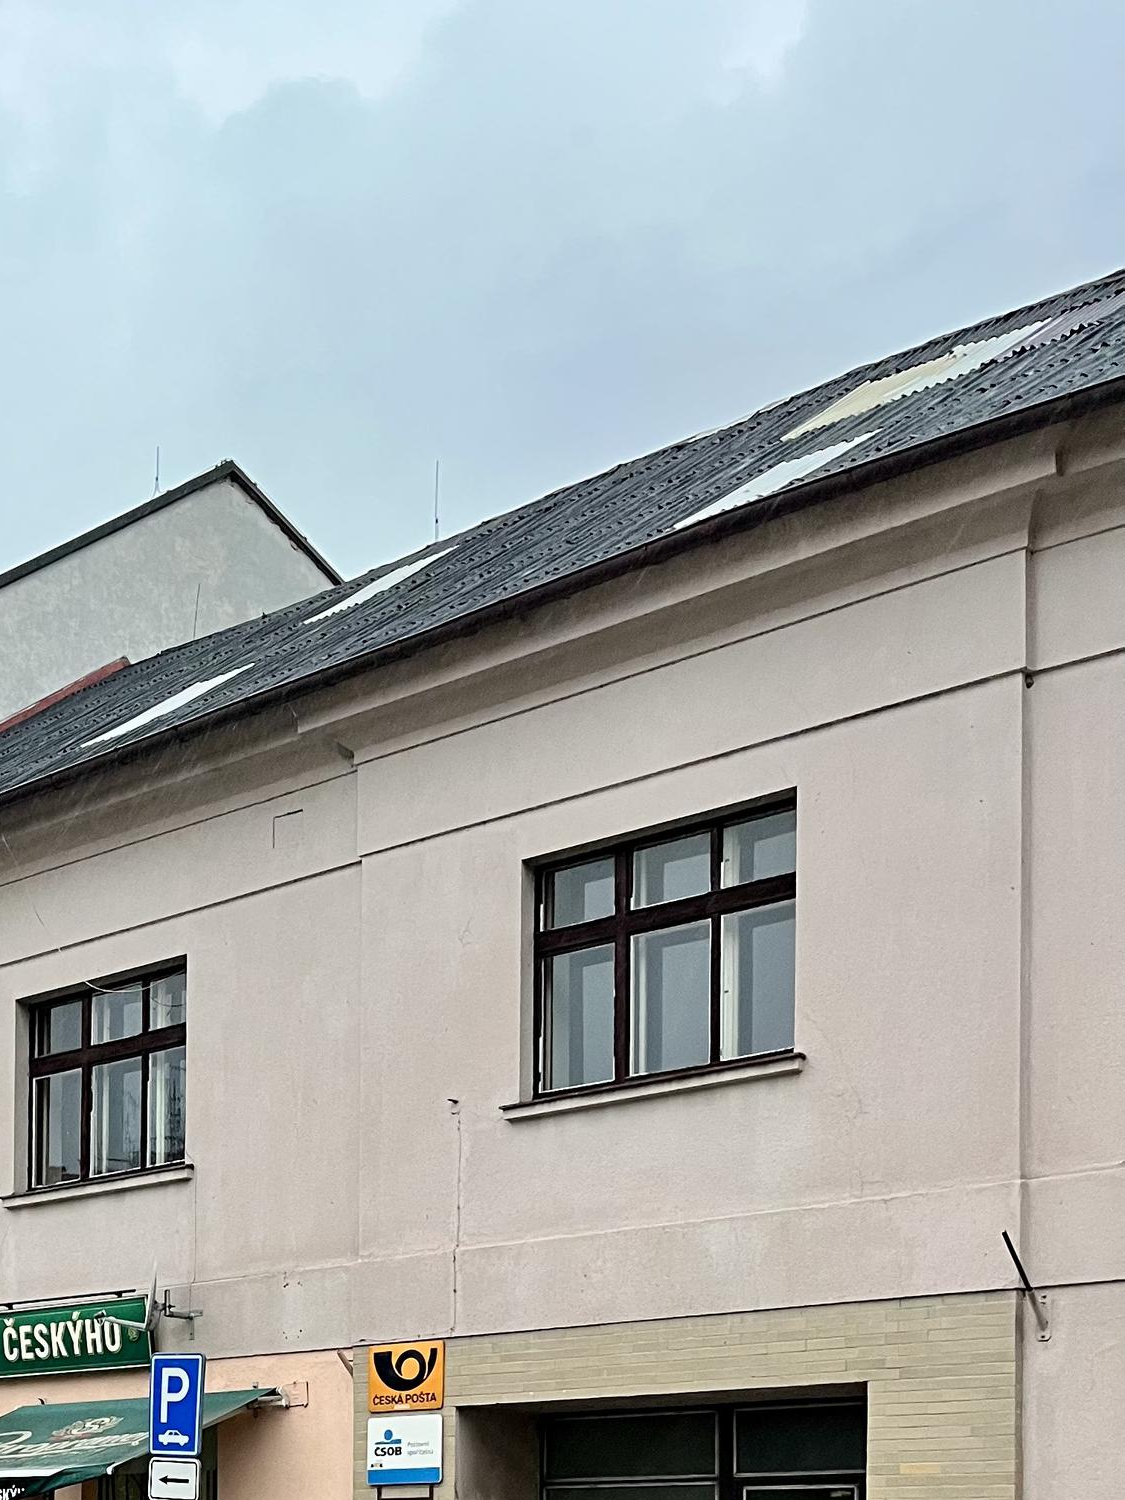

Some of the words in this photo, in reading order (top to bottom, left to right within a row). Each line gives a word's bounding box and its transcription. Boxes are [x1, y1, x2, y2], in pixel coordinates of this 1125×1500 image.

[2, 1311, 123, 1363] ČESKÝHO
[160, 1367, 190, 1424] P
[372, 1392, 404, 1406] ČESKÁ
[405, 1391, 437, 1404] POŠTA
[374, 1446, 402, 1457] ČSOB
